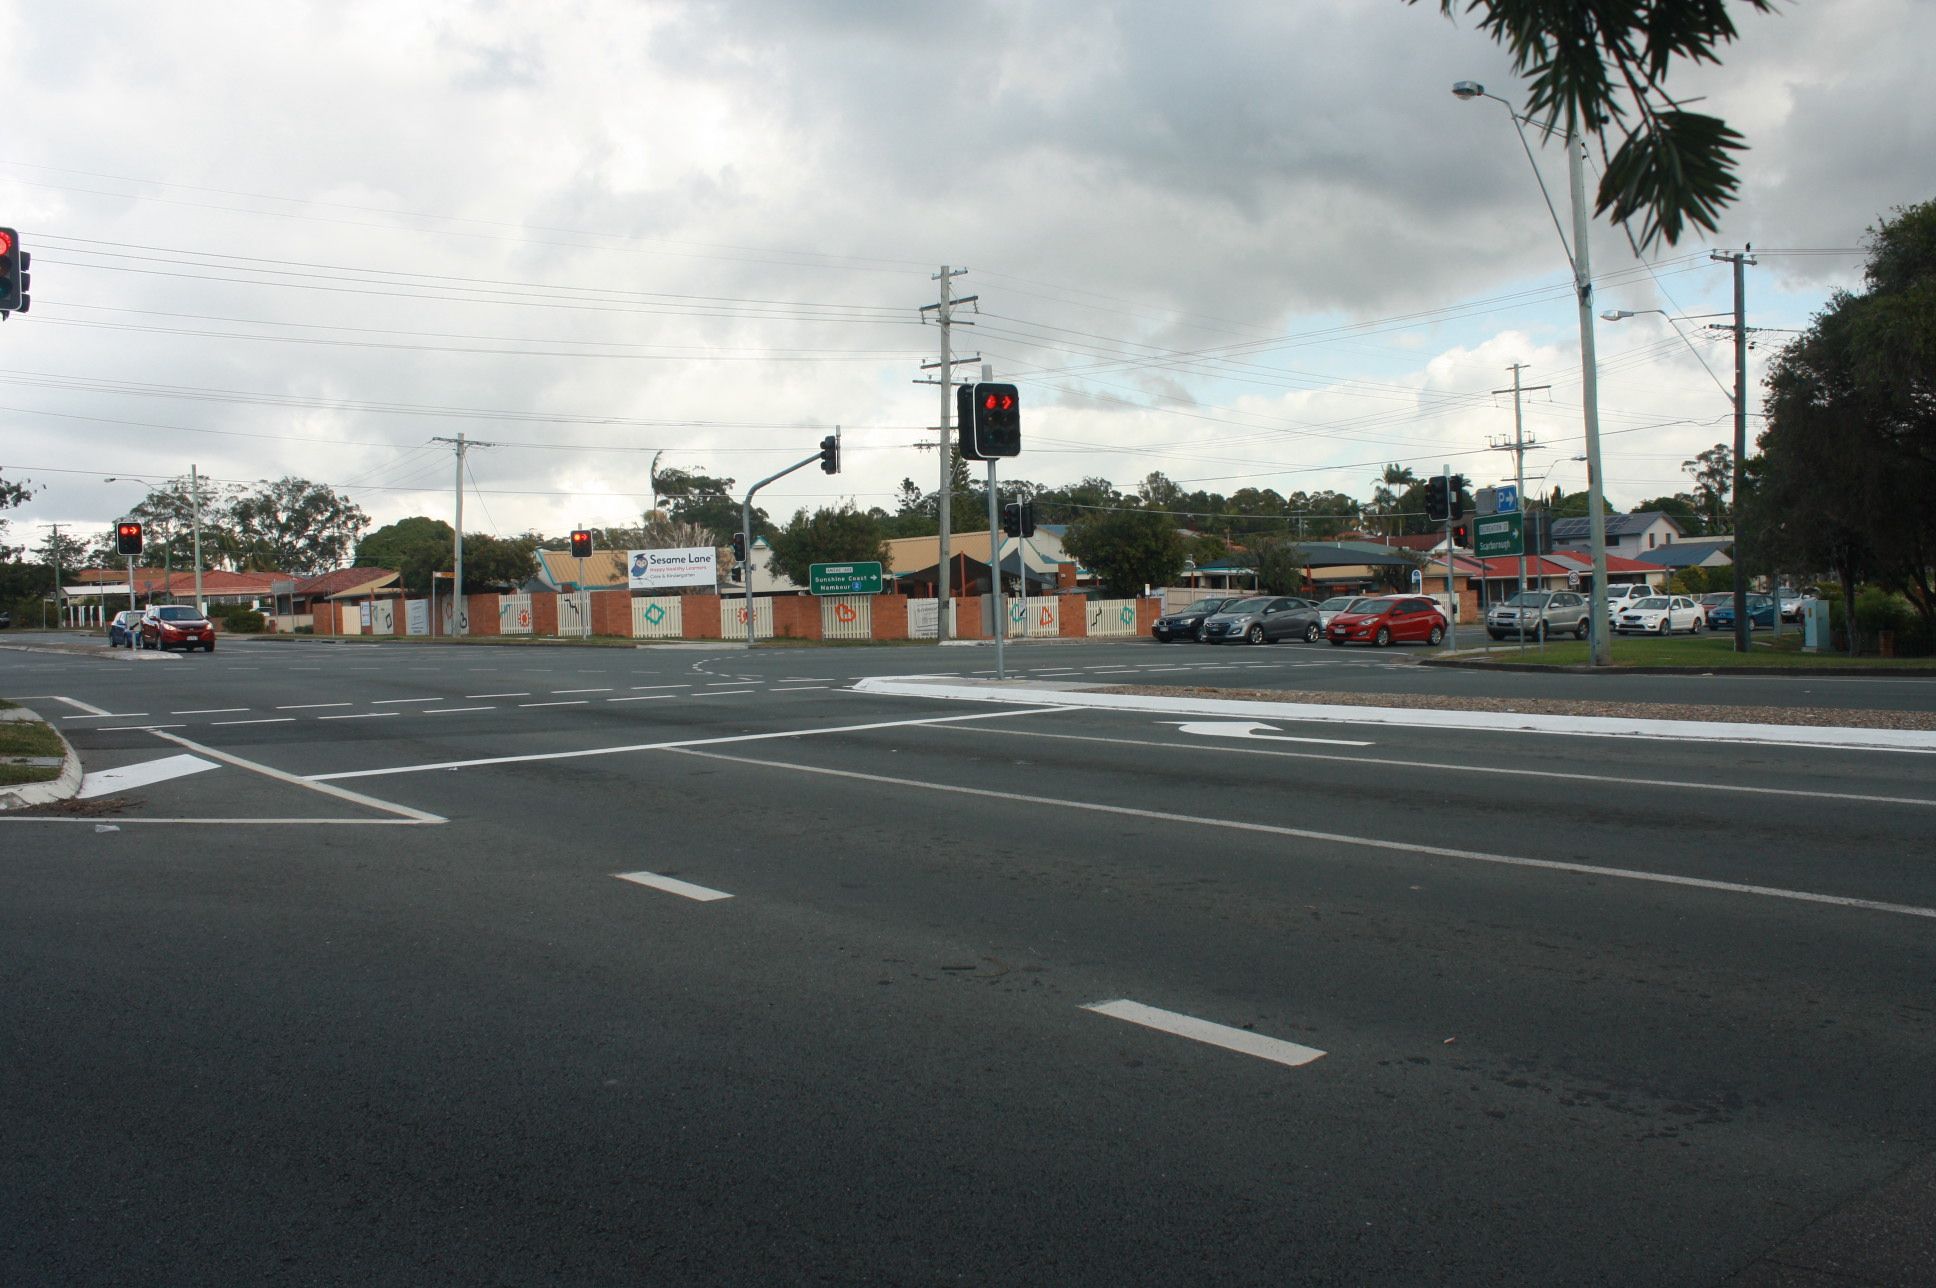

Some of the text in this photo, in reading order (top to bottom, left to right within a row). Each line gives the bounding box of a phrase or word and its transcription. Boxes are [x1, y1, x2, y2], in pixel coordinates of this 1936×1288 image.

[1498, 492, 1505, 508] P
[1480, 540, 1510, 551] Scarborough
[650, 553, 711, 564] Sesame Lane
